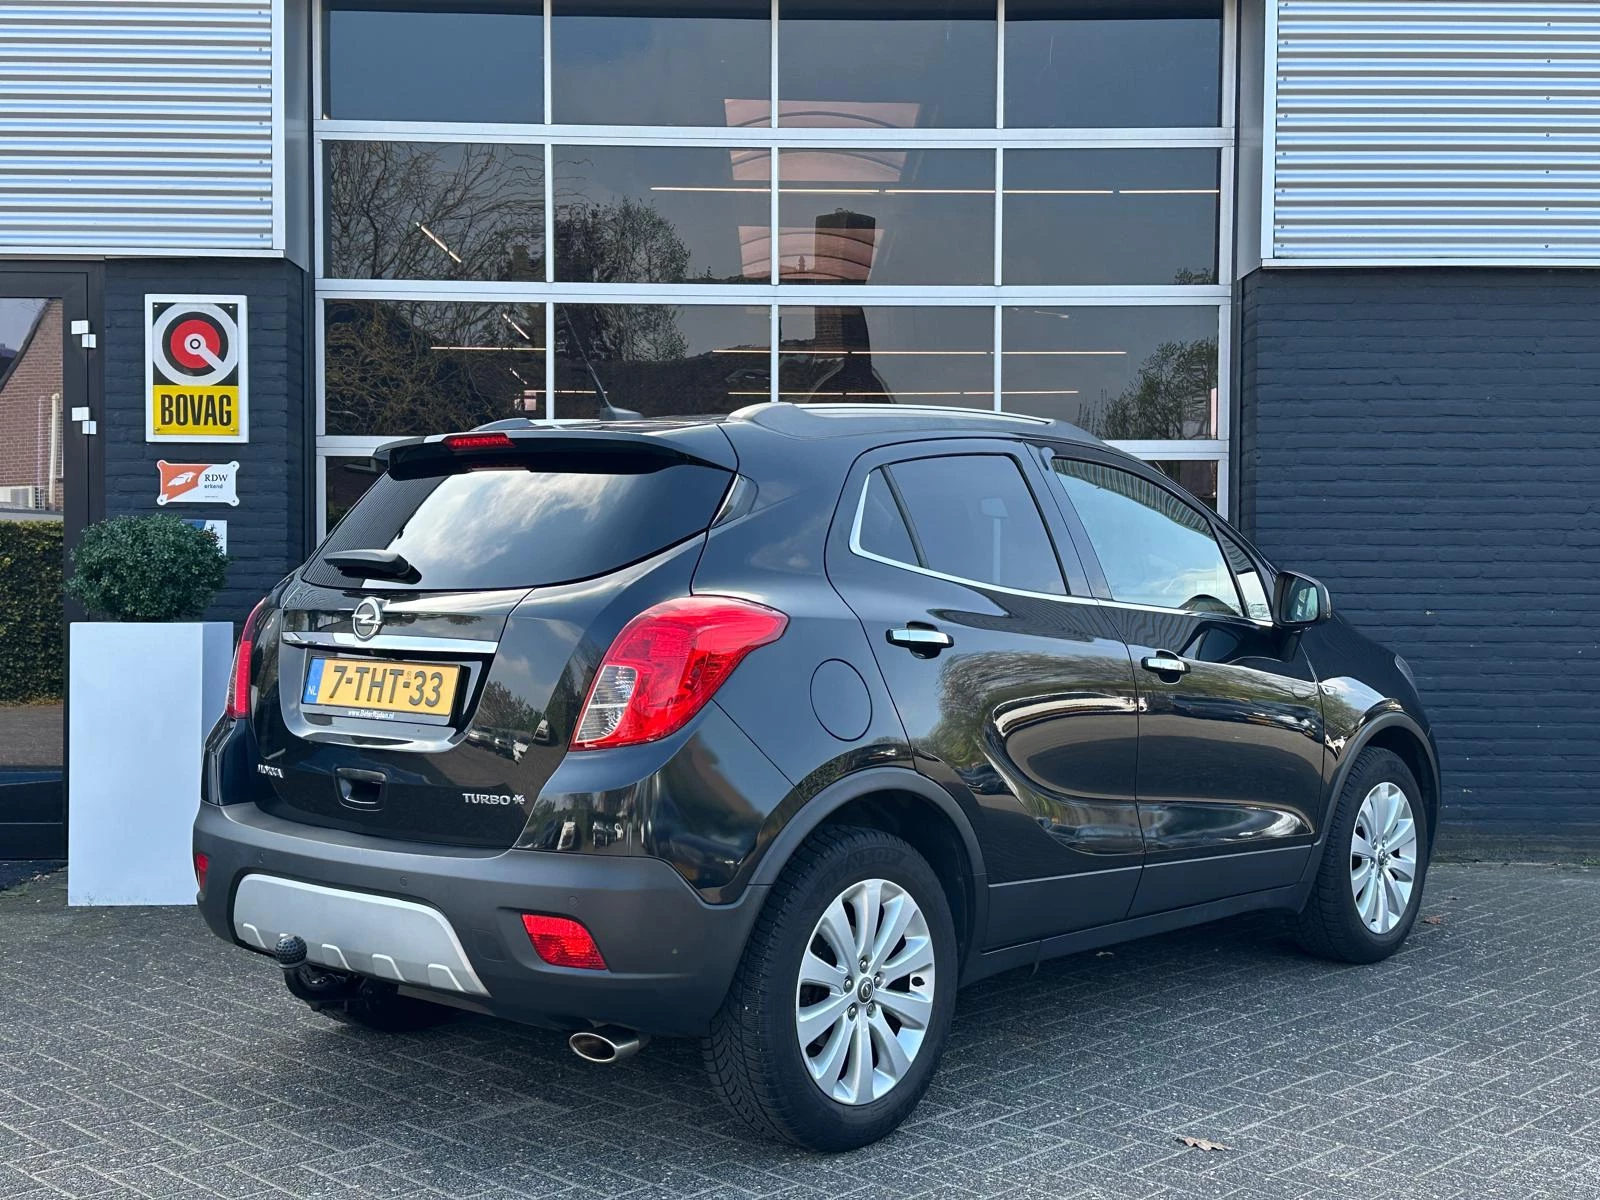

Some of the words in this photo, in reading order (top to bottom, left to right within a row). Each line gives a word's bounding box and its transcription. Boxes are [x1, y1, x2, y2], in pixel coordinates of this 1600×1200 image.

[160, 393, 232, 427] BOVAG
[204, 473, 229, 482] RDW
[307, 685, 317, 696] NL
[329, 665, 444, 708] 7-THT-33
[461, 793, 511, 806] TURBO
